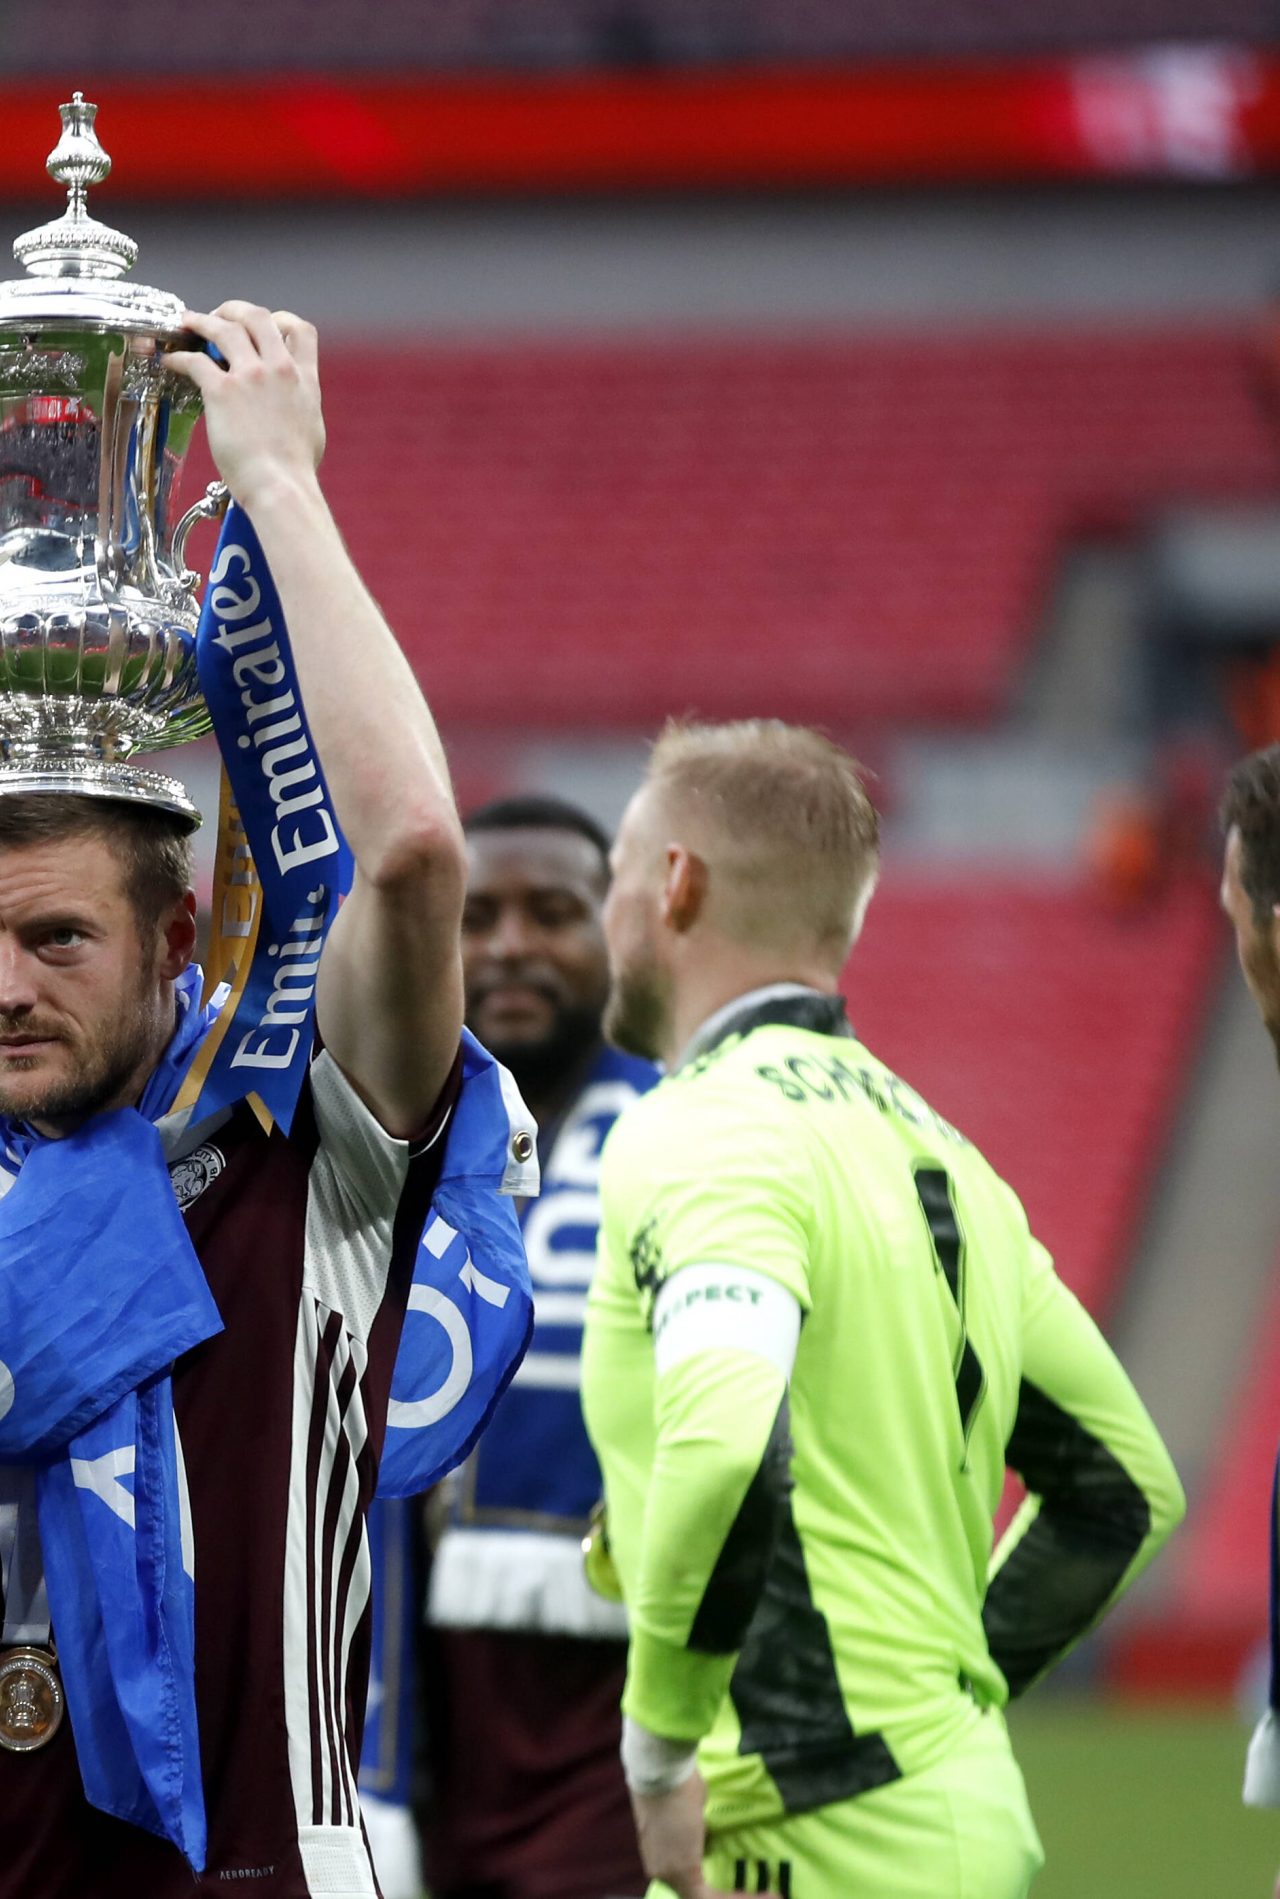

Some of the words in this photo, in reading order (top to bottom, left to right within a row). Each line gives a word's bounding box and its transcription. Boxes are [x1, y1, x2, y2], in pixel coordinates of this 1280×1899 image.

[210, 543, 340, 877] Emirates
[910, 1156, 988, 1474] 1
[220, 1865, 274, 1881] AEROREADY
